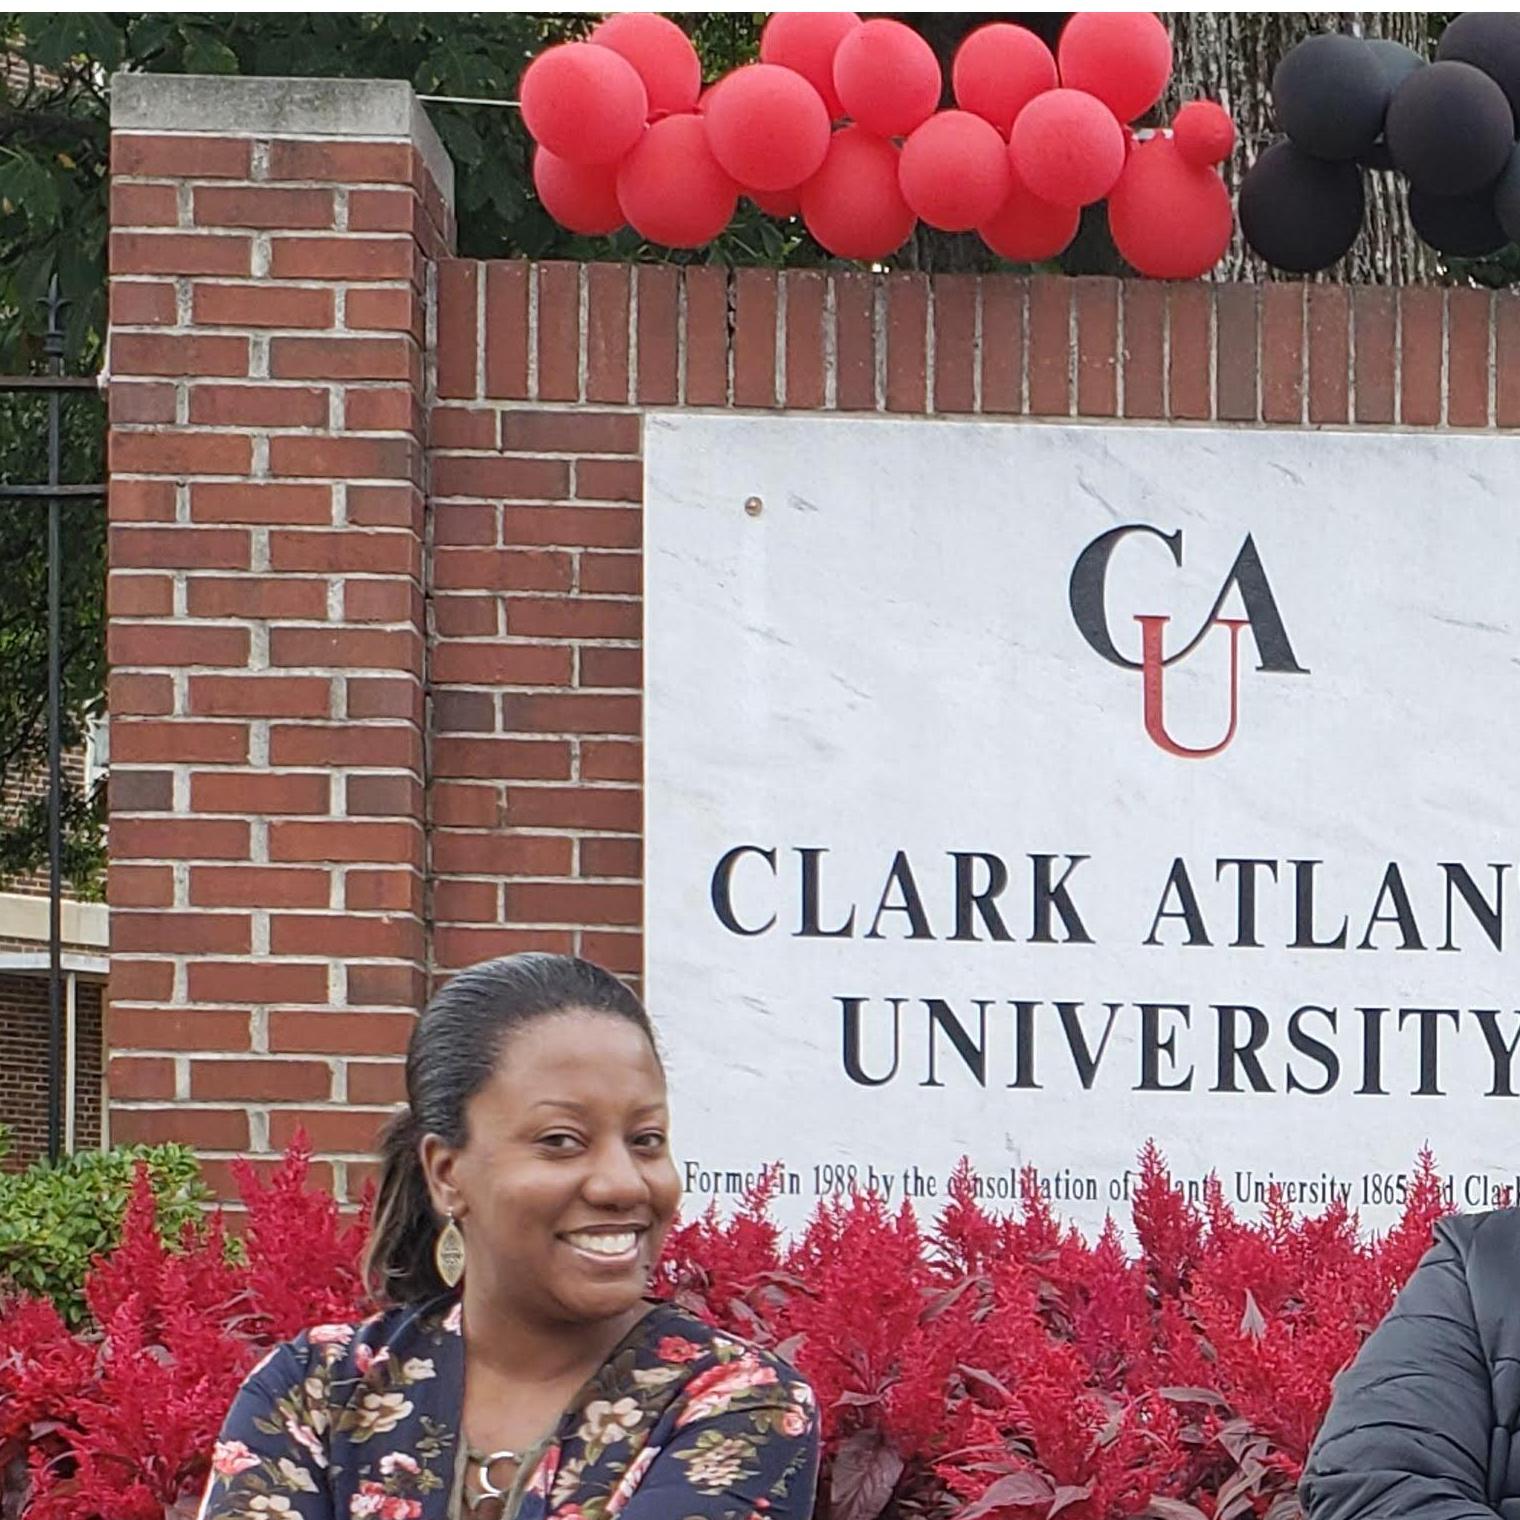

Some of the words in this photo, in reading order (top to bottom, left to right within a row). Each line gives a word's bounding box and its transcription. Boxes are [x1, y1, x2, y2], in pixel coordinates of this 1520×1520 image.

[711, 845, 1094, 944] CLARK
[684, 1161, 773, 1194] Formed
[813, 1164, 858, 1195] 1988
[868, 1165, 894, 1204] by
[903, 1166, 937, 1197] the
[1109, 1170, 1131, 1201] of
[1362, 1174, 1407, 1205] 1865
